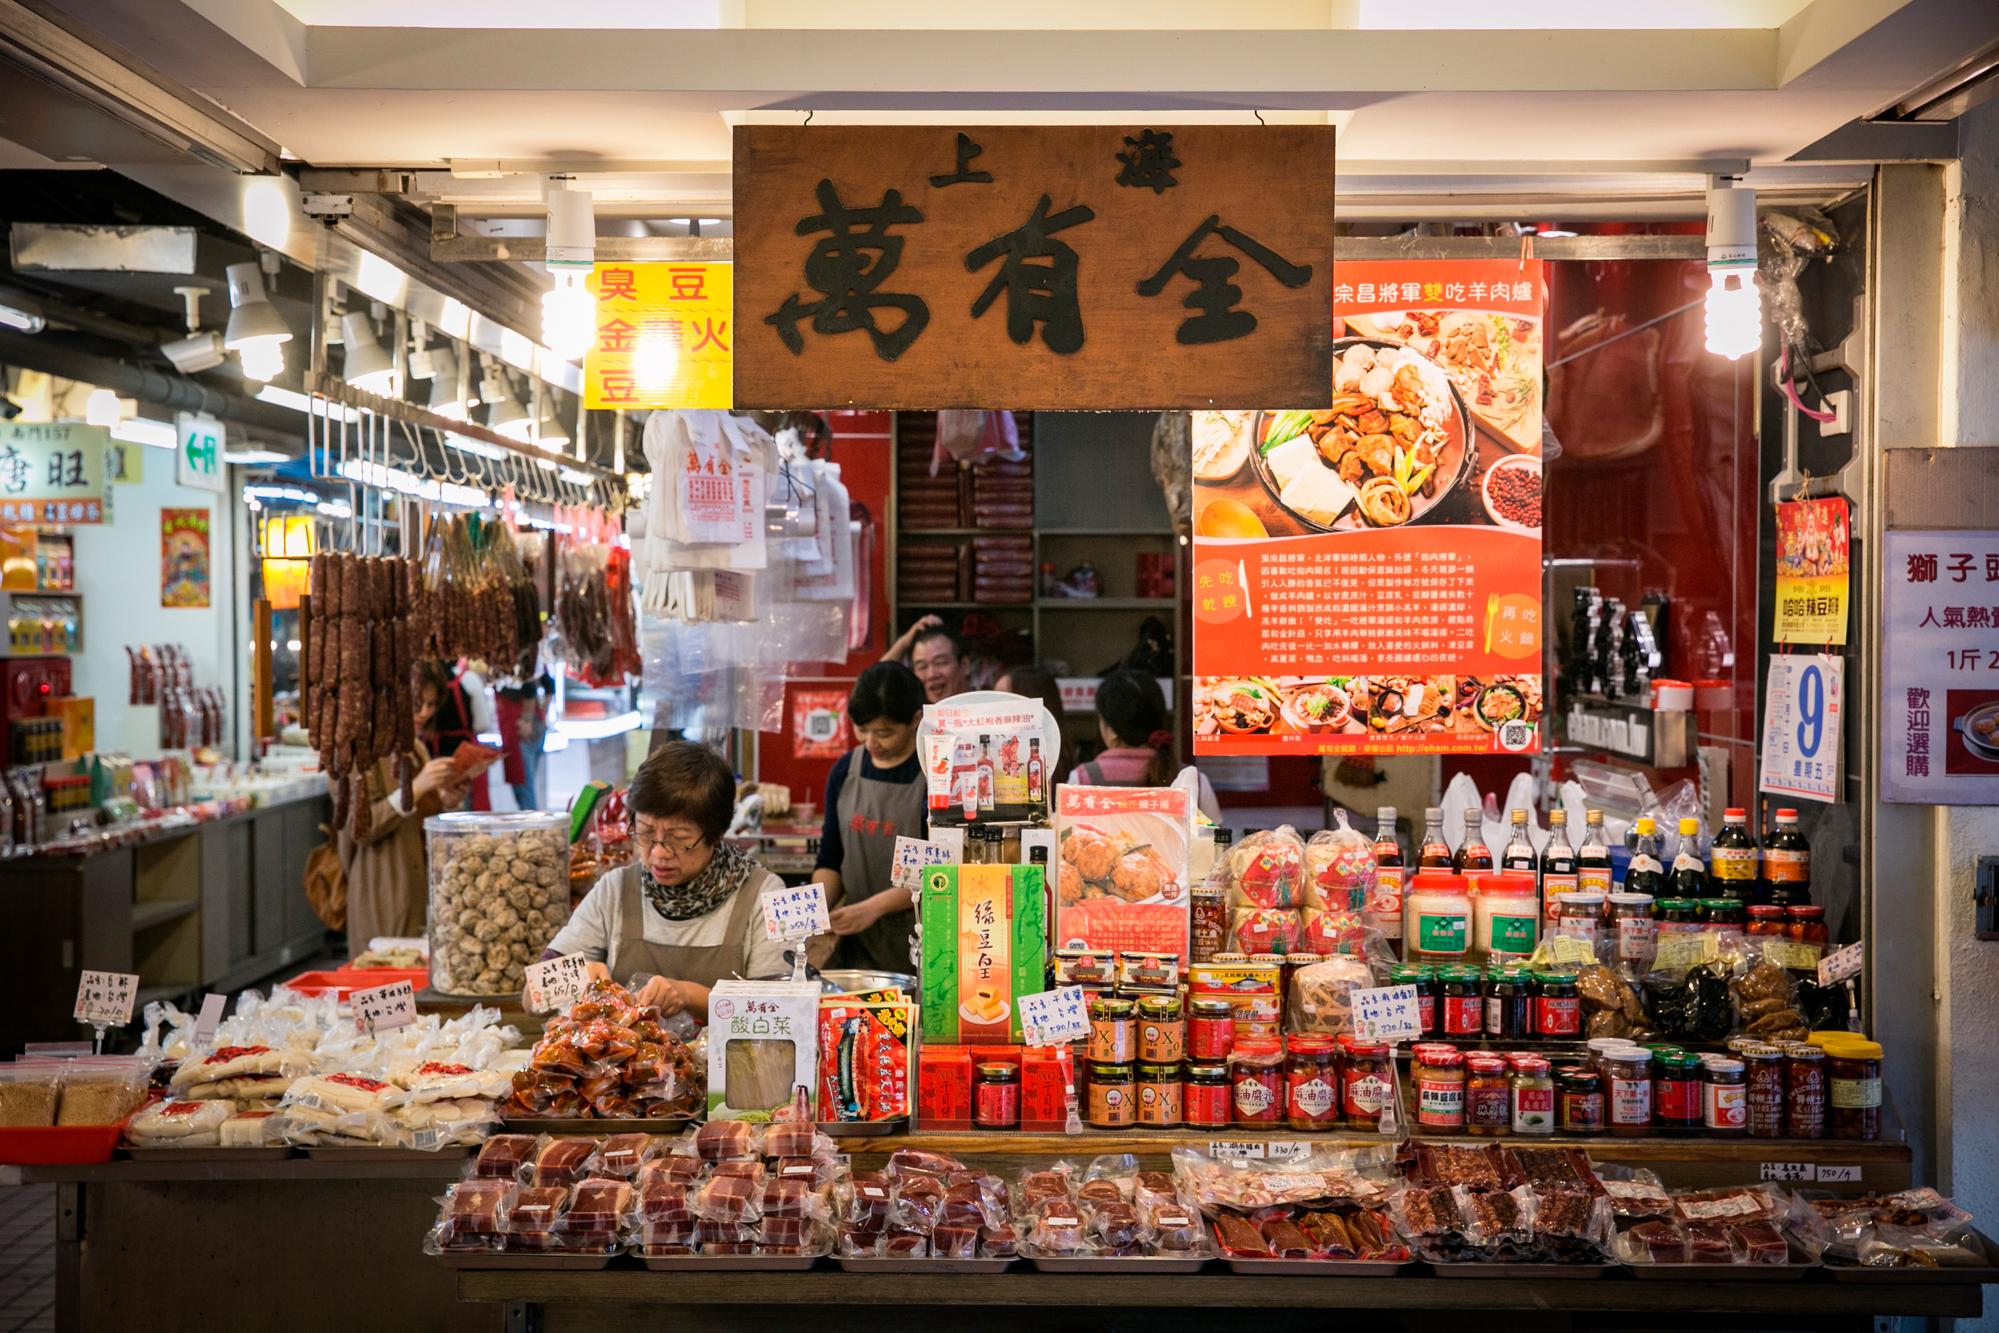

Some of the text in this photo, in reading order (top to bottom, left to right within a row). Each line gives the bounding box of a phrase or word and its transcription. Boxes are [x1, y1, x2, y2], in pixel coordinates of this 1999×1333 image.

[765, 179, 1312, 362] 萬有全
[1335, 281, 1533, 304] 宗昌將軍雙吃羊肉爐
[1797, 664, 1824, 758] 9
[1906, 687, 1930, 777] 歡迎選購
[974, 900, 996, 979] 綠豆皇
[730, 1016, 791, 1036] 酸白菜
[745, 1000, 780, 1014] 萬有全
[1350, 1088, 1382, 1101] 麻油腐
